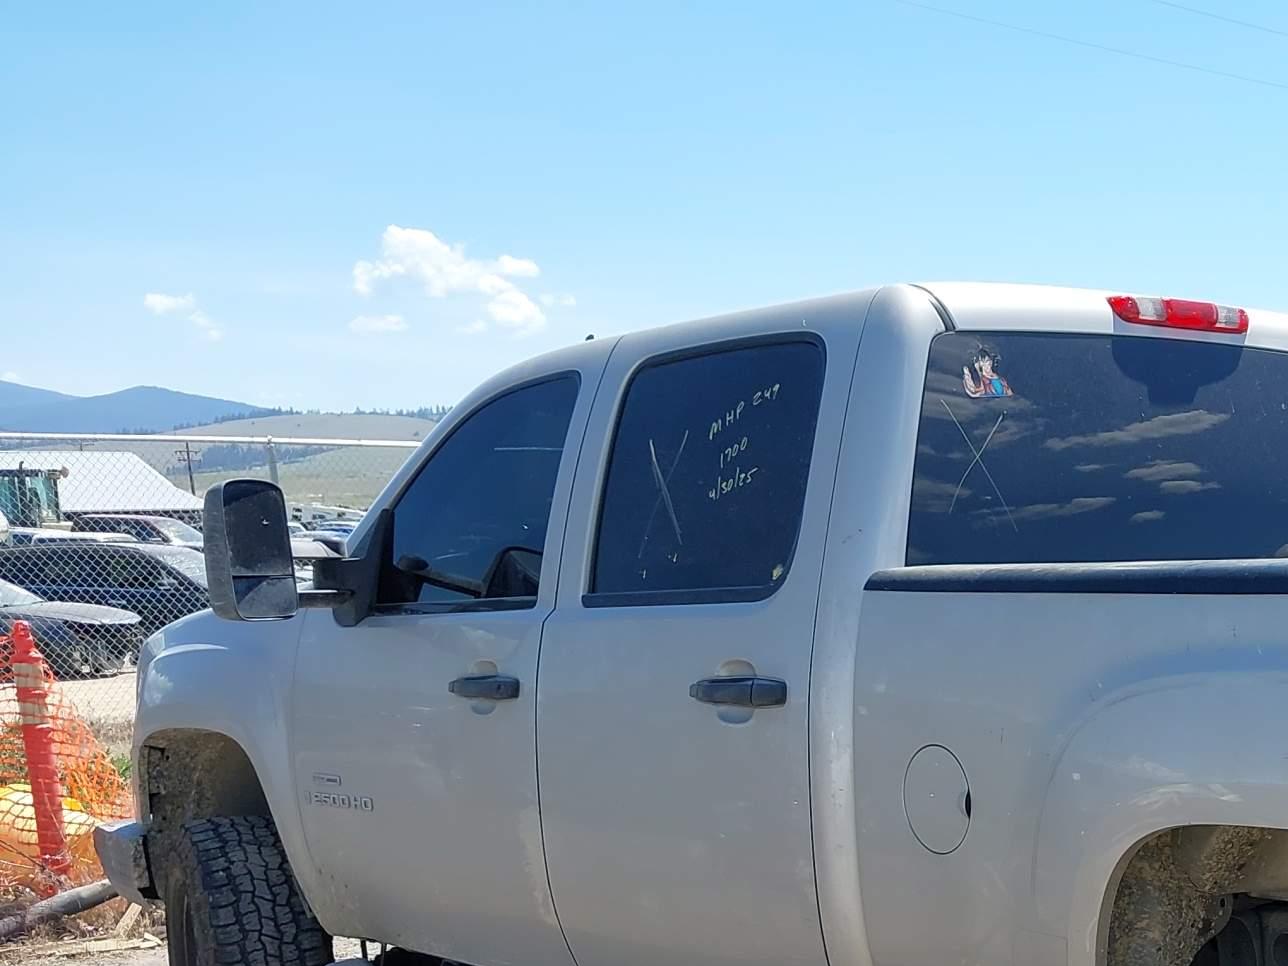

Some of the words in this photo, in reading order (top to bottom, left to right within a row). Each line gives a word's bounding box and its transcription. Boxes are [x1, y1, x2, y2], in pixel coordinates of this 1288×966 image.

[708, 401, 745, 440] MHP
[752, 383, 781, 406] 249
[720, 436, 748, 469] 1700
